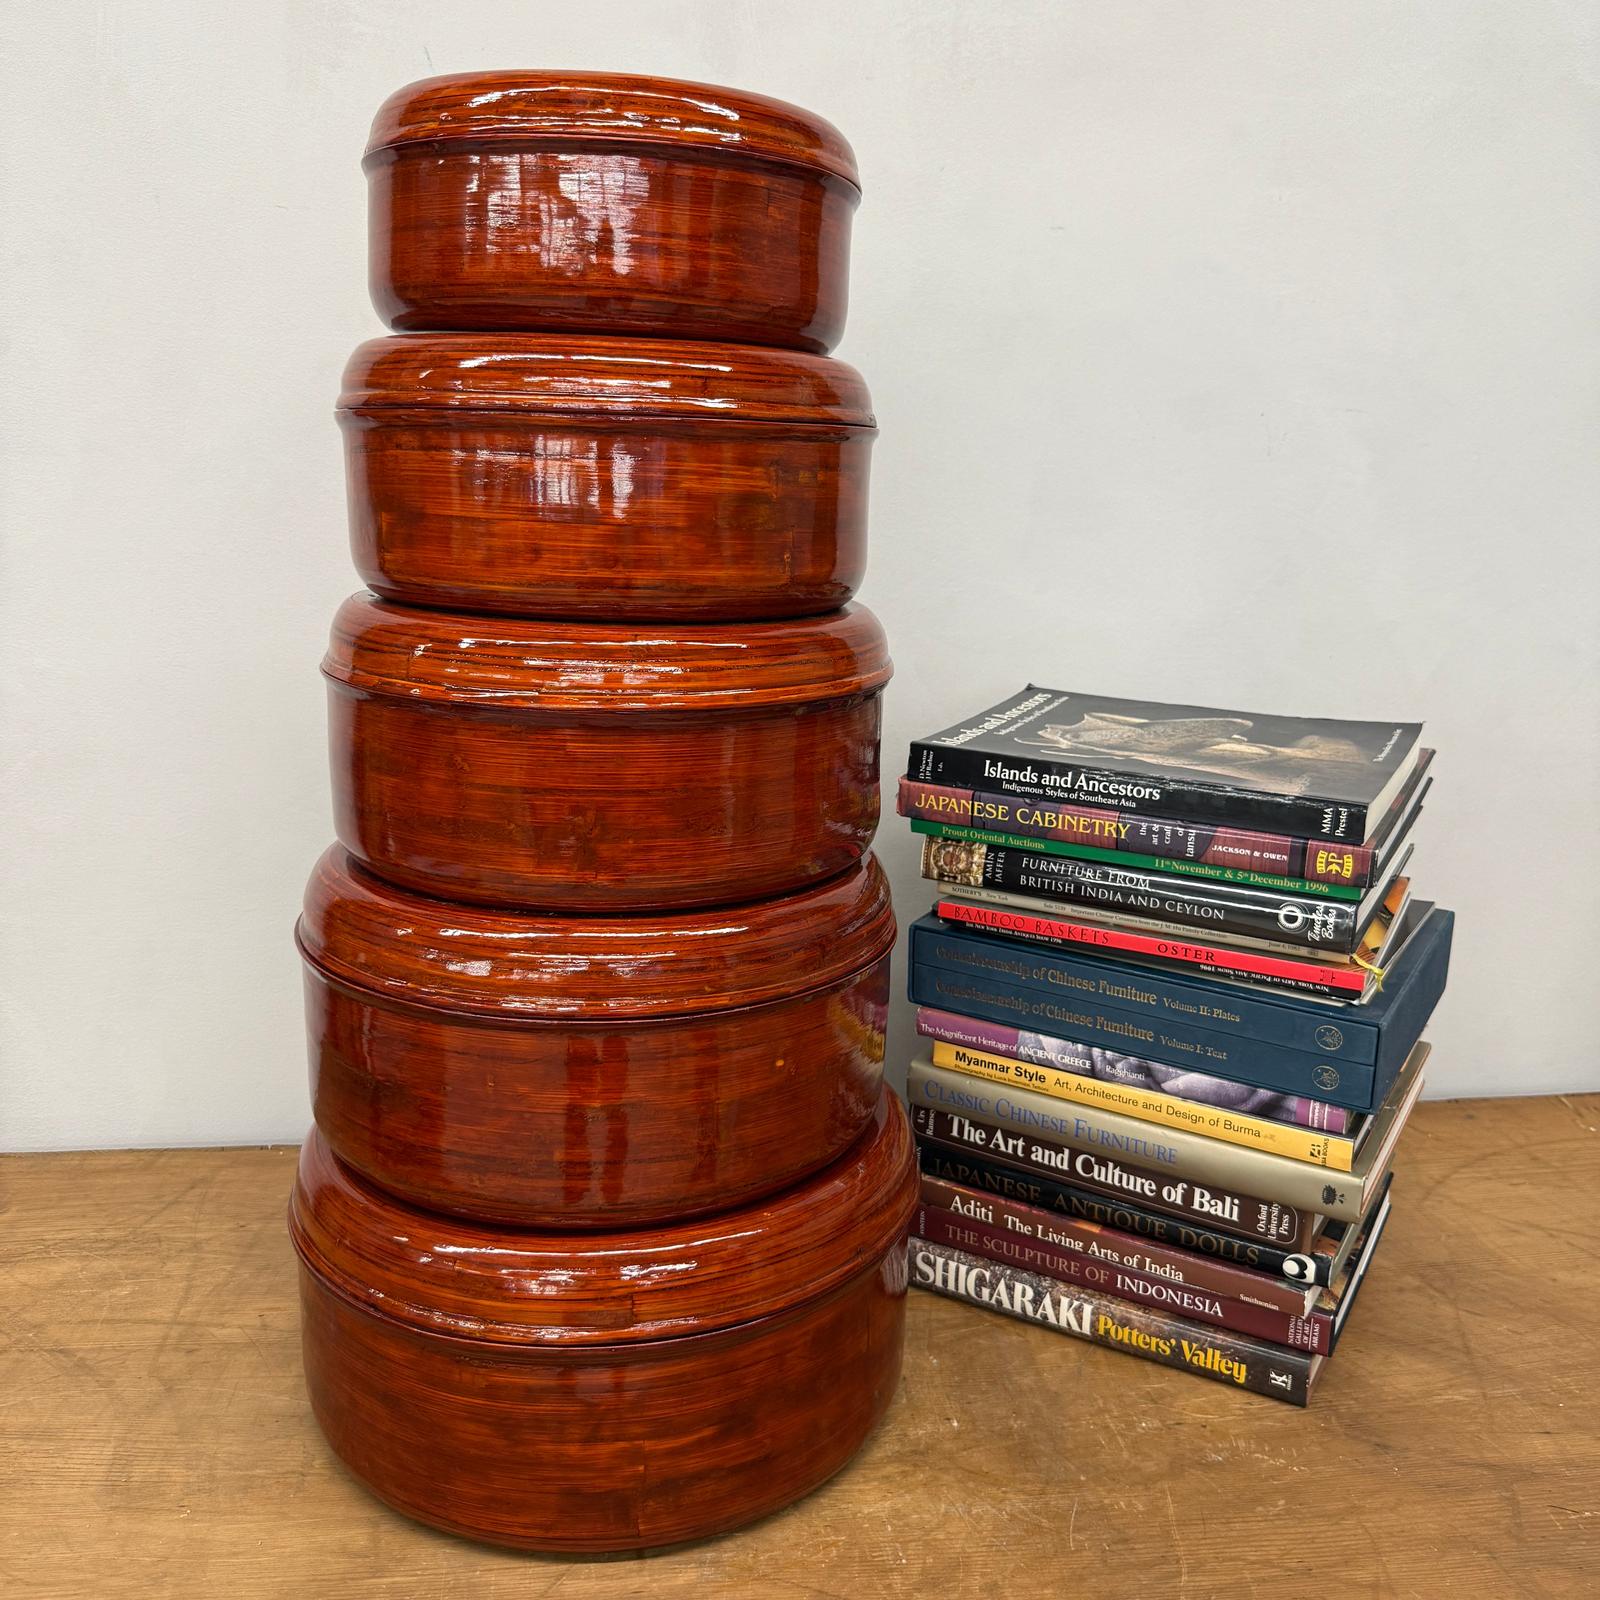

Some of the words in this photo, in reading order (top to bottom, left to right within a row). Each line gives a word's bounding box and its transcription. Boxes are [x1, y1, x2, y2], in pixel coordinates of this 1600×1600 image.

[919, 749, 928, 772] Newton
[984, 759, 1039, 784] Islands
[1041, 771, 1072, 788] and
[1074, 773, 1161, 802] Ancestors
[1002, 781, 1044, 796] Indigenous
[1045, 788, 1068, 799] Styles
[1069, 791, 1078, 800] of
[1079, 792, 1118, 806] Southeast
[1119, 798, 1137, 808] Asia
[915, 793, 1010, 821] JAPANESE
[1016, 807, 1131, 839] CABINETRY
[1140, 822, 1148, 836] the
[1152, 823, 1159, 833] &
[1321, 807, 1334, 834] MMA
[1334, 807, 1348, 837] Prestel
[942, 826, 968, 838] Proud
[969, 829, 1005, 844] Oriental
[1007, 836, 1045, 850] Auctions
[1164, 826, 1173, 845] craft
[1177, 827, 1185, 837] of
[1185, 829, 1197, 857] tansu
[985, 852, 995, 879] AMIN
[994, 851, 1006, 883] JAFFER
[1211, 844, 1251, 856] JACKSON
[1263, 851, 1289, 862] OWEN
[1022, 857, 1102, 880] FURNITURE
[1108, 870, 1150, 889] FROM
[1171, 861, 1222, 877] November
[1224, 869, 1233, 879] &
[1250, 873, 1301, 890] December
[1304, 881, 1329, 893] 1996
[1020, 875, 1074, 896] BRITISH
[1081, 886, 1123, 903] INDIA
[1128, 894, 1160, 909] AND
[1165, 900, 1225, 920] CEYLON
[954, 906, 1025, 929] BAMBOO
[1035, 920, 1109, 945] BASKETS
[1157, 943, 1216, 962] OSTER
[1321, 908, 1337, 939] Books
[1199, 964, 1215, 972] 1996
[1281, 978, 1296, 987] ARTS
[1032, 967, 1047, 980] of
[1047, 968, 1096, 992] Chinese
[1098, 979, 1157, 1005] Furniture
[1163, 997, 1198, 1013] Volume
[1199, 1005, 1211, 1016] II:
[1212, 1008, 1241, 1022] Plates
[1298, 981, 1314, 989] YORK
[1032, 1002, 1047, 1015] of
[1046, 1004, 1093, 1027] Chinese
[1095, 1016, 1154, 1042] Furniture
[1160, 1035, 1195, 1052] Volume
[1196, 1044, 1204, 1055] I:
[1205, 1046, 1228, 1060] Text
[921, 1023, 935, 1033] The
[935, 1026, 977, 1044] Magnificent
[978, 1036, 1008, 1051] Heritage
[1009, 1043, 1018, 1052] of
[1018, 1045, 1056, 1061] ANCIENT
[1057, 1054, 1092, 1069] GREECE
[1105, 1064, 1145, 1081] Ragghianti
[955, 1051, 1010, 1075] Myanmar
[1014, 1066, 1046, 1083] Style
[1054, 1078, 1072, 1092] Art,
[1075, 1083, 1139, 1107] Architecture
[1142, 1099, 1162, 1113] and
[1166, 1105, 1204, 1124] Design
[1209, 1117, 1220, 1126] of
[1223, 1119, 1261, 1138] Burma
[924, 1079, 990, 1113] CLASSIC
[995, 1098, 1068, 1134] CHINESE
[1074, 1117, 1178, 1163] FURNITURE
[948, 1113, 986, 1145] The
[989, 1128, 1026, 1157] Art
[1030, 1144, 1069, 1171] and
[1075, 1153, 1157, 1197] Culture
[1162, 1182, 1188, 1205] of
[1190, 1187, 1241, 1222] Bali
[934, 1158, 1041, 1201] JAPANESE
[1054, 1193, 1168, 1239] ANTIQUE
[1178, 1226, 1260, 1265] DOLLS
[1257, 1203, 1269, 1232] Oxford
[1267, 1201, 1281, 1240] University
[1279, 1214, 1291, 1235] Press
[950, 1195, 994, 1224] Aditi
[1003, 1214, 1033, 1235] The
[1037, 1224, 1084, 1252] Living
[1088, 1241, 1119, 1262] Arts
[1124, 1255, 1141, 1269] of
[1144, 1257, 1183, 1281] India
[1239, 1293, 1280, 1311] Smithsonian
[945, 1223, 979, 1246] THE
[983, 1236, 1081, 1276] SCULPTURE
[1085, 1266, 1110, 1284] OF
[1116, 1273, 1223, 1318] INDONESIA
[915, 1251, 1094, 1336] SHIGARAKI
[1097, 1314, 1176, 1356] Potters'
[1180, 1339, 1248, 1384] Valley
[1303, 1322, 1311, 1336] ART
[1302, 1335, 1309, 1344] OF
[1311, 1323, 1320, 1348] ABRAMS
